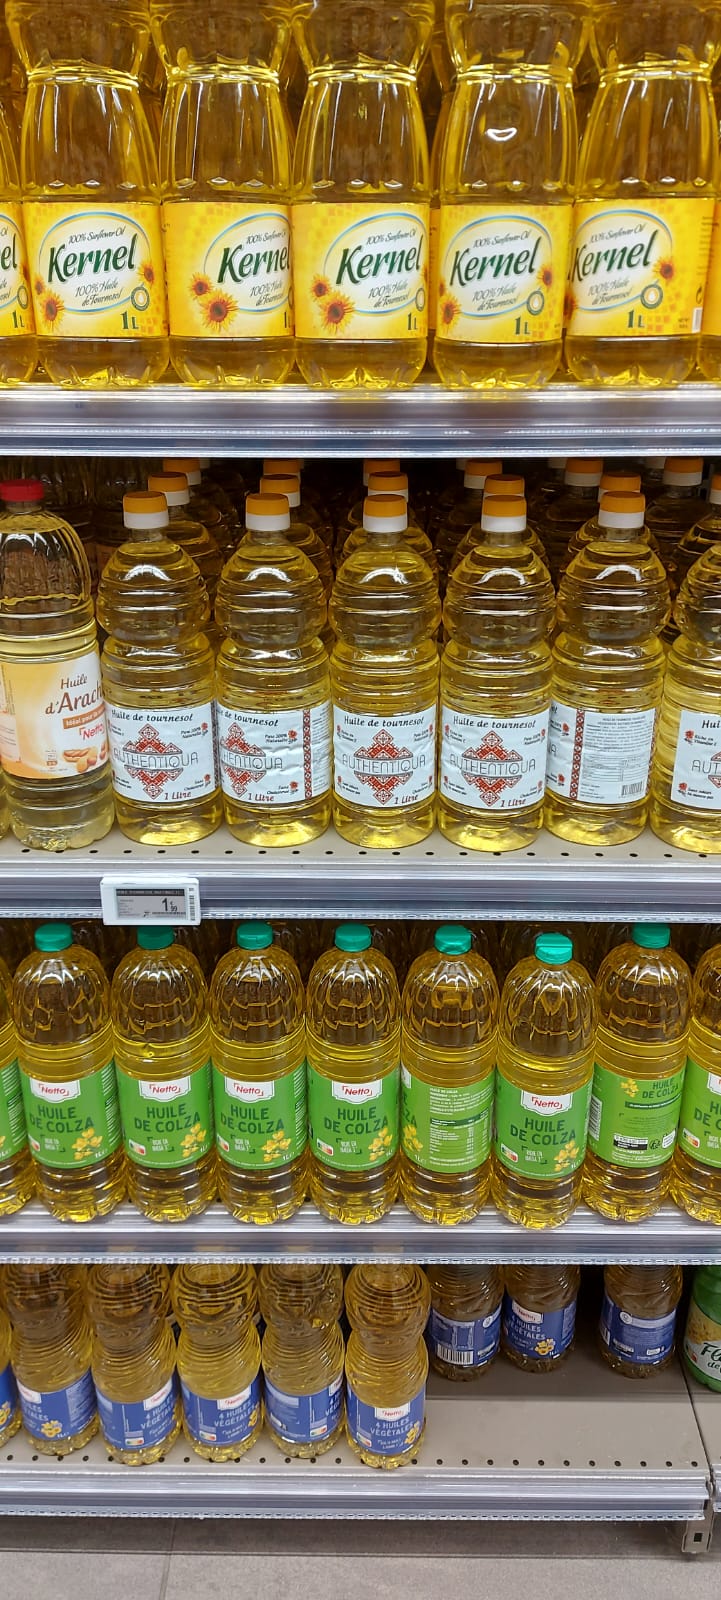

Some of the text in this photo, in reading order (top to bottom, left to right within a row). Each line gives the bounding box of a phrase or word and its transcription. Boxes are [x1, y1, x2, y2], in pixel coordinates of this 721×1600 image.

[68, 233, 87, 244] 100%
[115, 225, 126, 237] Oil
[246, 233, 262, 244] 100%
[366, 233, 384, 245] 100%
[409, 228, 417, 239] Oil
[473, 236, 491, 248] 100%
[520, 229, 531, 241] Oil
[589, 231, 607, 244] 100%
[634, 224, 646, 236] Oil
[48, 233, 137, 283] Kernel
[336, 234, 423, 285] Kernel
[450, 236, 542, 287] Kernel
[571, 229, 659, 283] Kernel
[75, 284, 98, 297] 100%
[250, 285, 268, 297] 100%
[368, 286, 390, 298] 100%
[473, 289, 496, 303] 100%
[588, 282, 610, 296] 100%
[60, 673, 88, 690] Huile
[45, 680, 102, 715] d'Arach
[111, 709, 194, 722] Huile de tournesol
[225, 711, 279, 727] de tournesol
[344, 715, 425, 728] Huile de tournesol
[453, 715, 536, 729] Huile de tournesol
[702, 720, 721, 729] Hui
[113, 747, 199, 769] AUTHENTIQUA
[223, 753, 283, 770] HENTIQUA
[342, 753, 426, 774] AUTHENTIQUA
[449, 753, 536, 776] AUTHENTIQUA
[164, 791, 192, 800] 1 Litre
[248, 792, 275, 802] 1 Litre
[394, 794, 419, 805] 1 Litre
[500, 798, 527, 808] 1 Litre
[162, 897, 169, 912] 1
[41, 1086, 66, 1095] Netto
[152, 1085, 177, 1094] Netto
[236, 1086, 261, 1095] Netto
[653, 1078, 673, 1090] HUILE
[344, 1088, 370, 1096] Netto
[642, 1090, 654, 1099] DE
[146, 1103, 186, 1118] HUILE
[535, 1100, 560, 1108] Netto
[38, 1105, 76, 1119] HUILE
[230, 1104, 269, 1121] HUILE
[337, 1106, 377, 1121] HUILE
[694, 1107, 711, 1126] DE
[29, 1112, 94, 1133] DE COLZA
[134, 1111, 201, 1133] DE COLZA
[220, 1112, 285, 1134] DE COLZA
[324, 1115, 388, 1135] DE COLZA
[525, 1118, 565, 1132] HUILE
[510, 1124, 576, 1146] DE COLZA
[382, 1417, 409, 1428] HUILES
